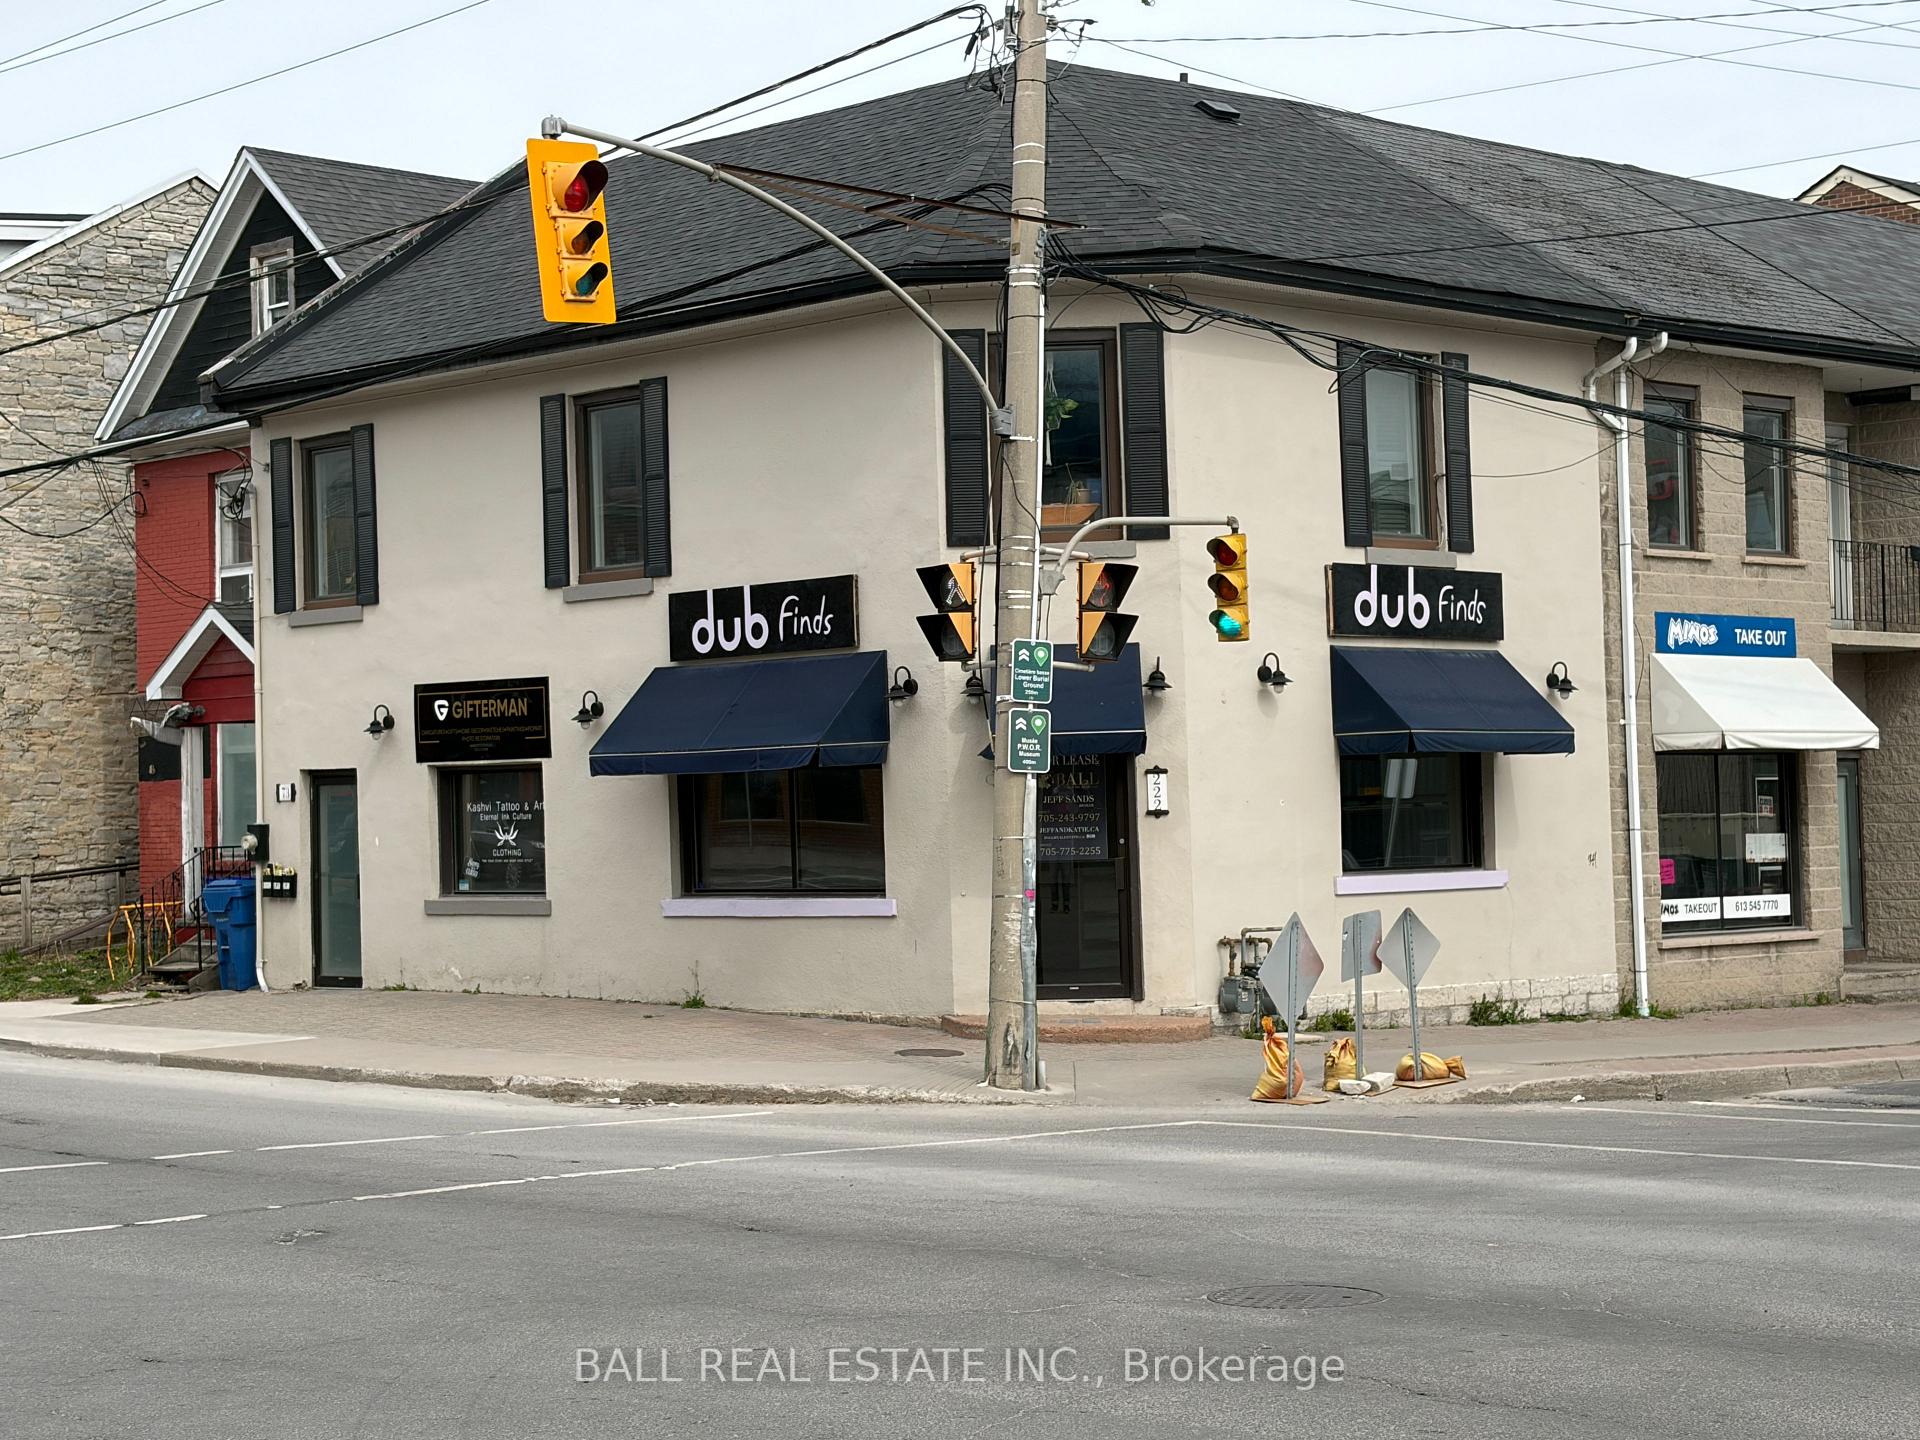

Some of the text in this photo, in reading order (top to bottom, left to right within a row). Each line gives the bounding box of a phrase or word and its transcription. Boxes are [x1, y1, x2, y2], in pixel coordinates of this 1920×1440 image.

[1354, 564, 1430, 629] dub
[691, 584, 769, 654] dub
[1667, 617, 1787, 650] MINOS TAKE OUT
[452, 697, 528, 719] GIFTERMAN
[1017, 743, 1042, 751] P.W.O.R.
[1063, 754, 1100, 766] LEASE
[1058, 772, 1100, 785] BALL
[1043, 794, 1095, 804] JEFF SANDS
[466, 801, 492, 813] Kashvi
[496, 800, 520, 812] Tattoo
[524, 801, 529, 811] &
[480, 812, 532, 821] Eternal Ink Culture
[492, 849, 521, 857] CLOTHING
[1040, 846, 1101, 856] 705-775-2255
[1684, 903, 1718, 914] TAKEOUT
[1735, 899, 1779, 912] 613 545 7770
